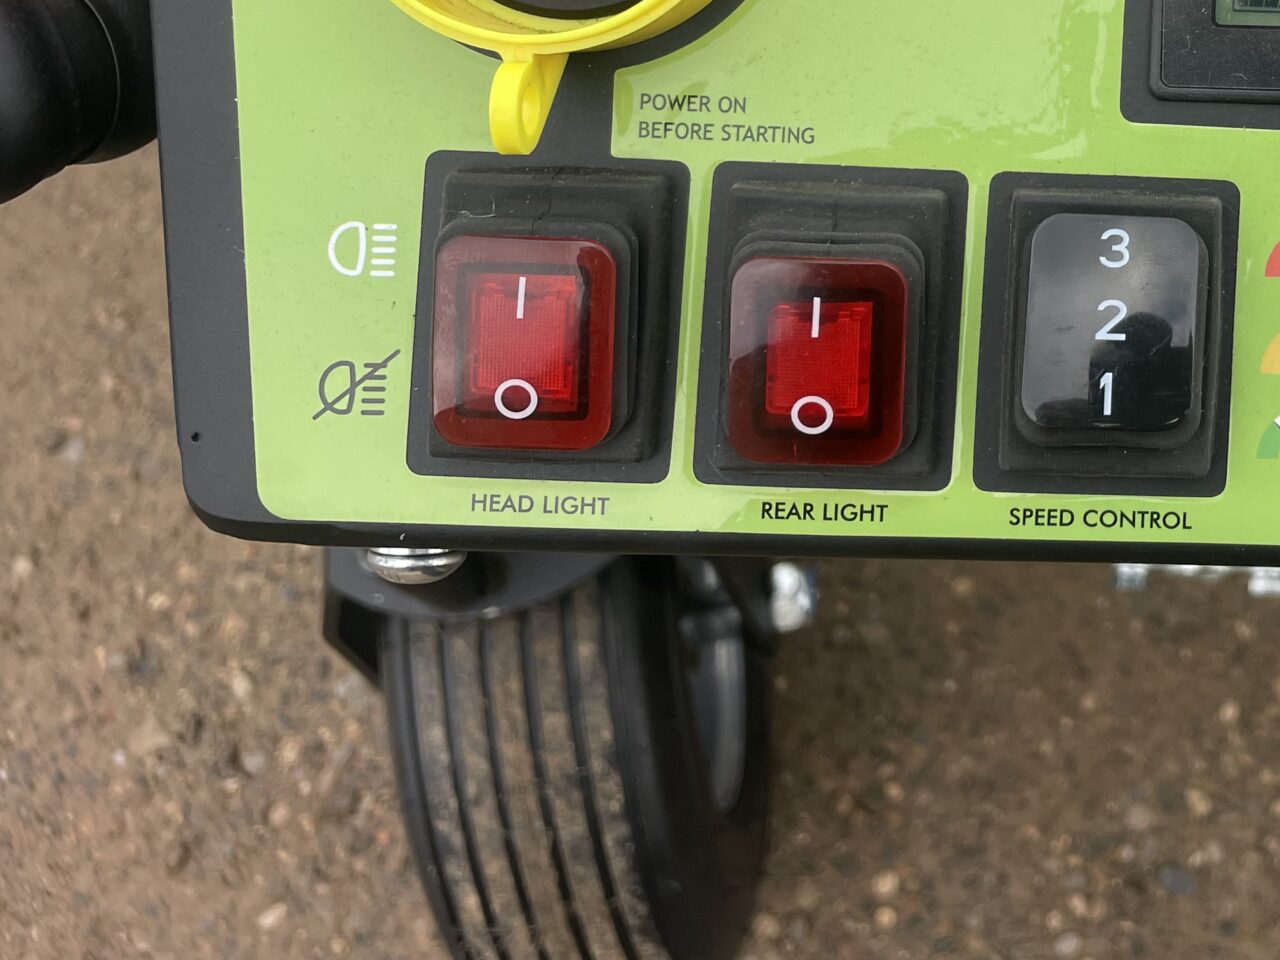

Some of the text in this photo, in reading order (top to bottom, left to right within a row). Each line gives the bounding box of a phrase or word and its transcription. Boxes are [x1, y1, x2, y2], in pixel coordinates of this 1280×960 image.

[640, 92, 747, 114] POWER ON
[638, 120, 815, 145] BEFORE STARTING
[1098, 228, 1130, 269] 3
[1094, 298, 1128, 341] 2
[1099, 371, 1114, 416] 1
[471, 493, 611, 516] HEAD LIGHT
[761, 501, 889, 523] REAR LIGHT
[1009, 507, 1193, 530] SPEED CONTROL
